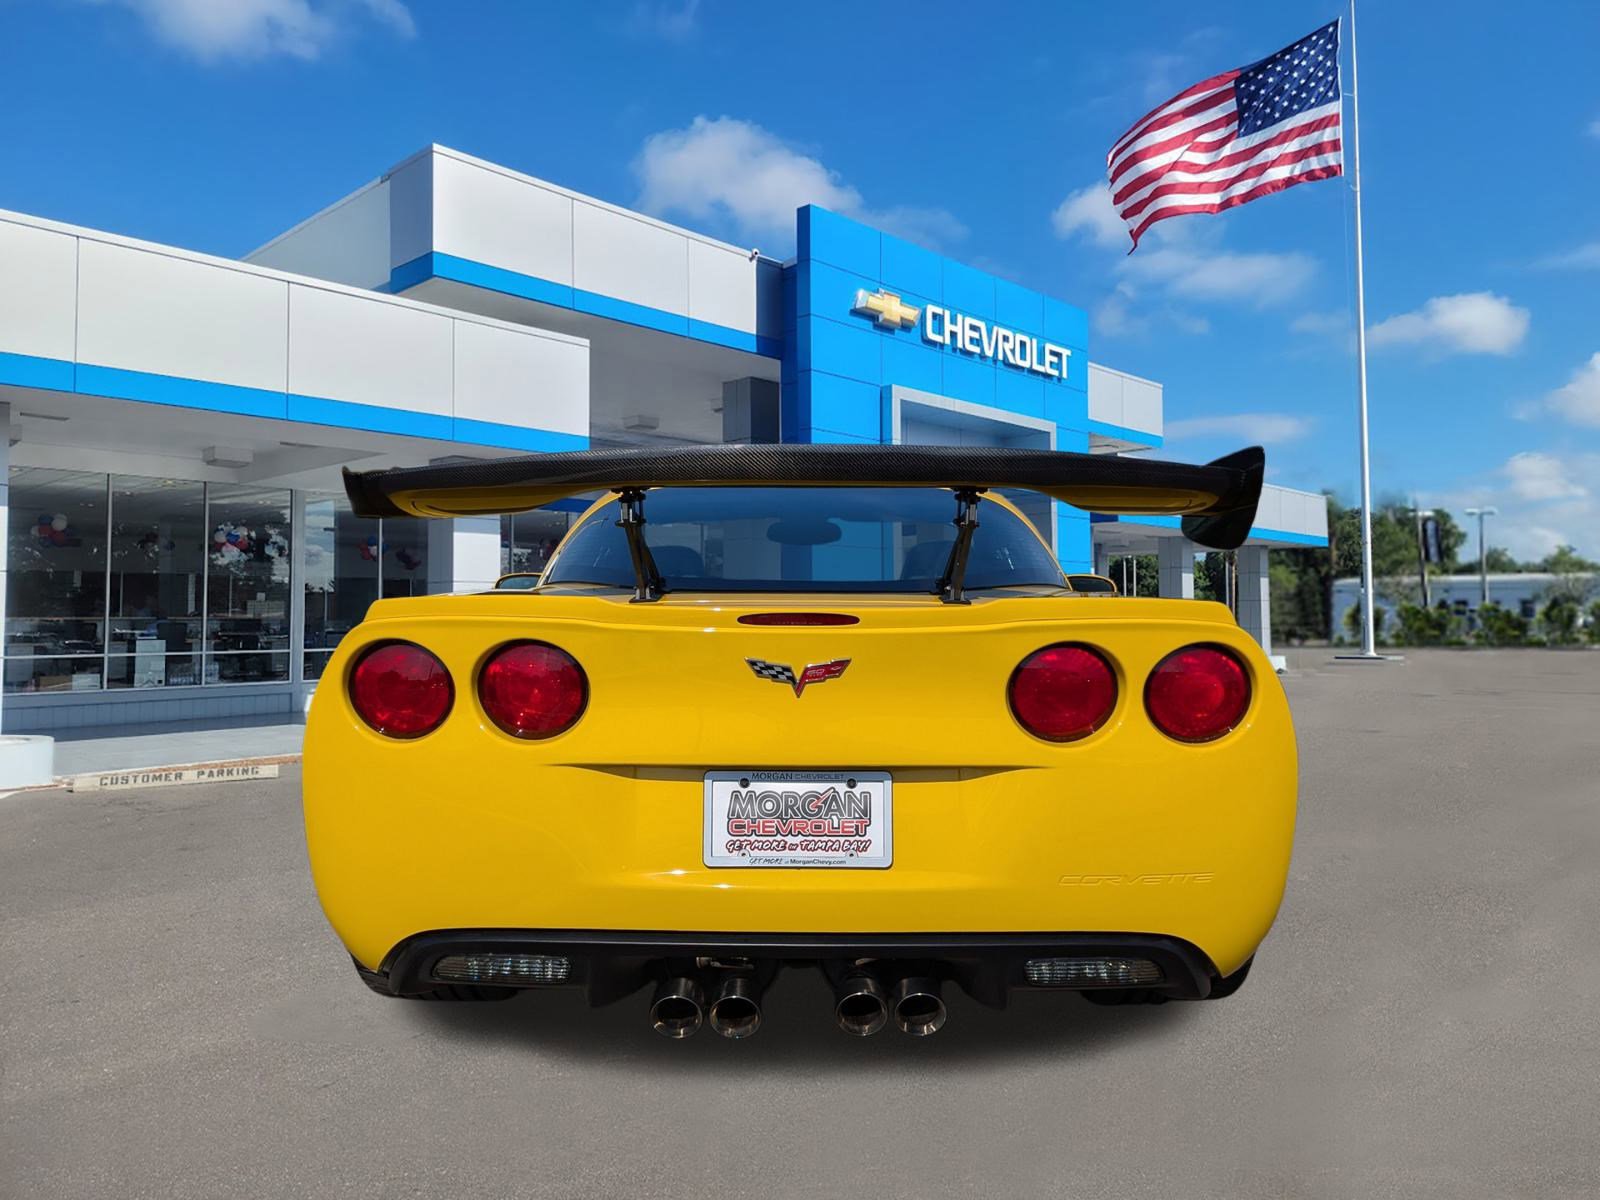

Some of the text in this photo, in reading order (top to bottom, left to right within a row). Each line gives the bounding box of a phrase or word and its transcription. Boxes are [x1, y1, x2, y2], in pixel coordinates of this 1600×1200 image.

[925, 304, 1072, 379] CHEVROLET
[100, 766, 259, 786] CUSTOMER PARKING
[751, 772, 793, 780] MORGAN
[727, 788, 871, 819] MORGAN
[727, 818, 871, 837] CHEVROLET
[726, 839, 750, 853] GET
[750, 839, 786, 852] MORE
[799, 839, 841, 852] TAMPA
[841, 839, 872, 852] BAY!
[1058, 872, 1215, 886] CORVETTE
